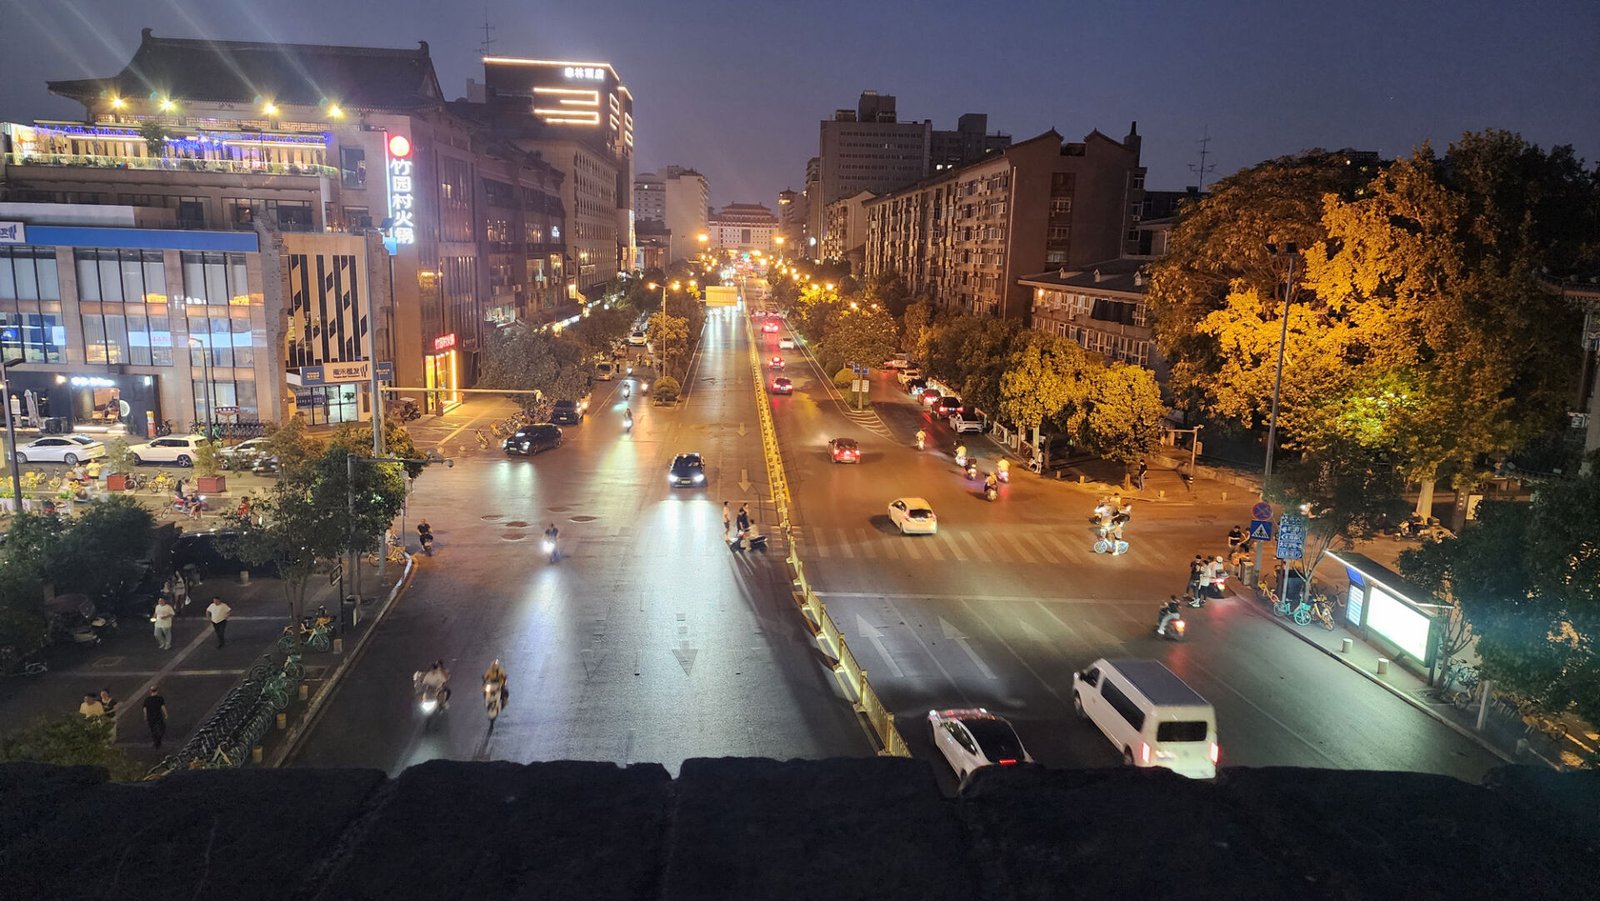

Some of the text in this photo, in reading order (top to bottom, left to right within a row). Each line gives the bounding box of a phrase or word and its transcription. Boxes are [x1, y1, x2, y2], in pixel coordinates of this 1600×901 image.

[390, 158, 414, 244] 竹园村火锅
